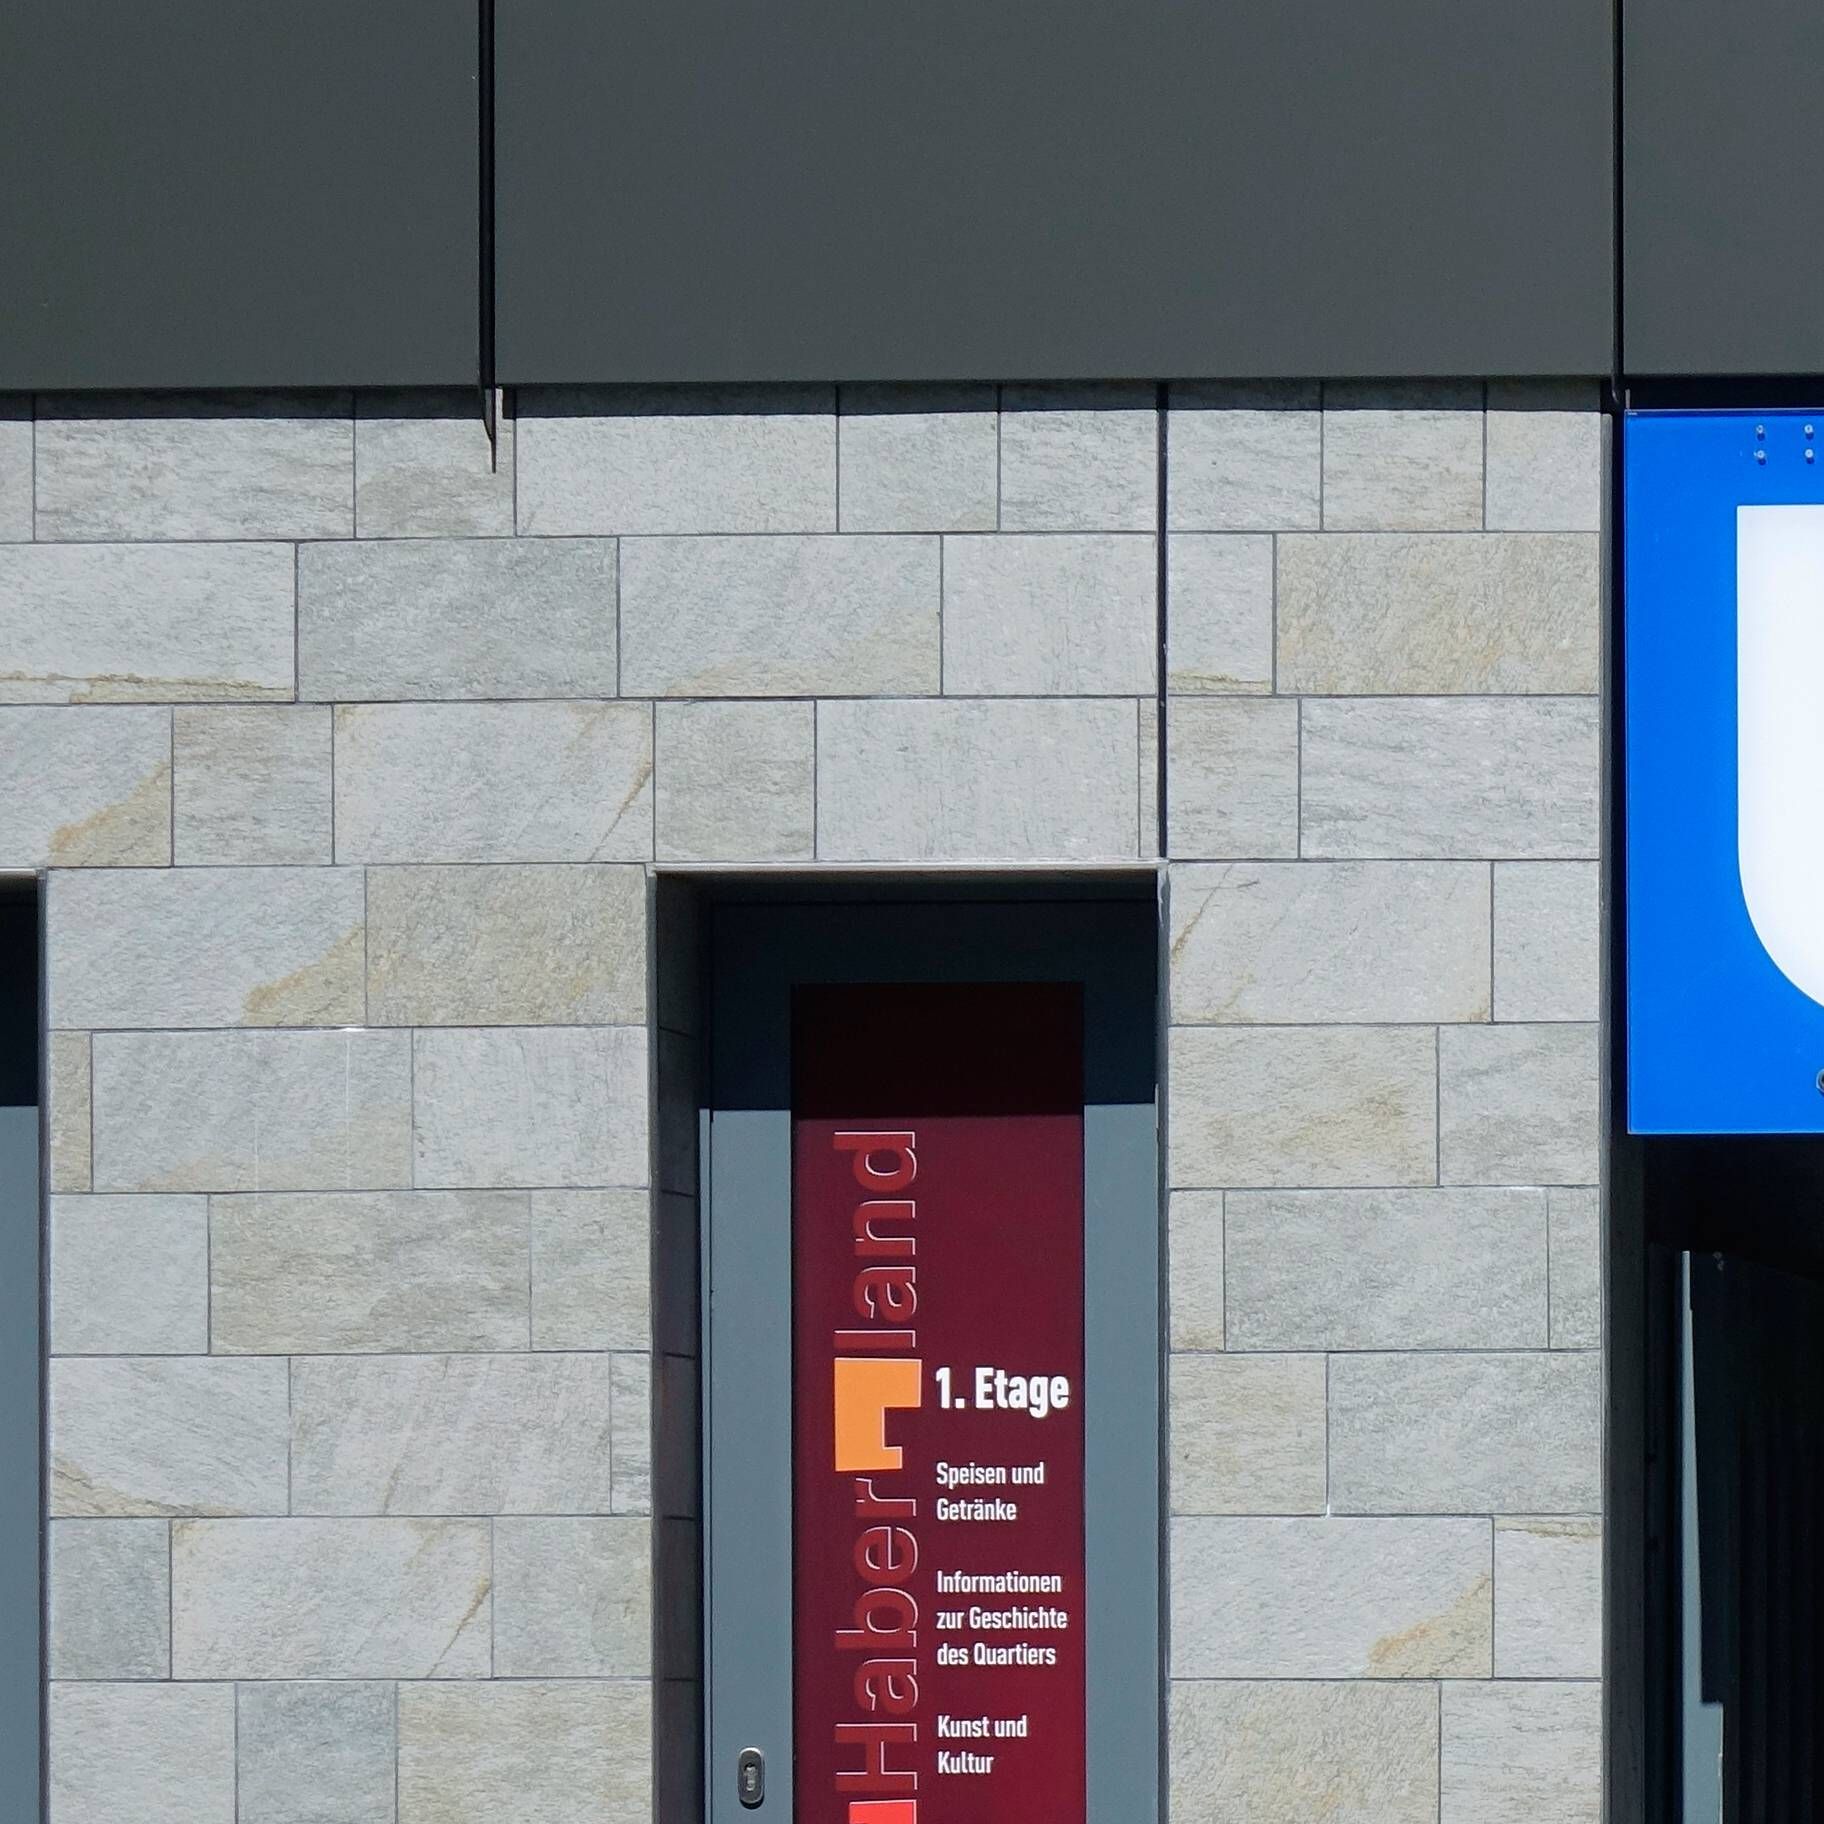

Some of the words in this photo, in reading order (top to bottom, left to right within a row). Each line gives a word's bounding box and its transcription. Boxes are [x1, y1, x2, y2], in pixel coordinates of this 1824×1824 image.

[935, 1366, 966, 1410] 1.
[974, 1366, 1070, 1419] Etage
[936, 1461, 1007, 1490] Speisen
[1011, 1461, 1045, 1485] und
[936, 1497, 1018, 1522] Getränke
[936, 1569, 1063, 1594] Informationen
[936, 1611, 966, 1631] zur
[969, 1605, 1068, 1630] Geschichte
[936, 1642, 970, 1666] des
[973, 1641, 1057, 1667] Quartiers
[937, 1714, 991, 1739] Kunst
[994, 1713, 1028, 1738] und
[937, 1750, 995, 1775] Kultur
